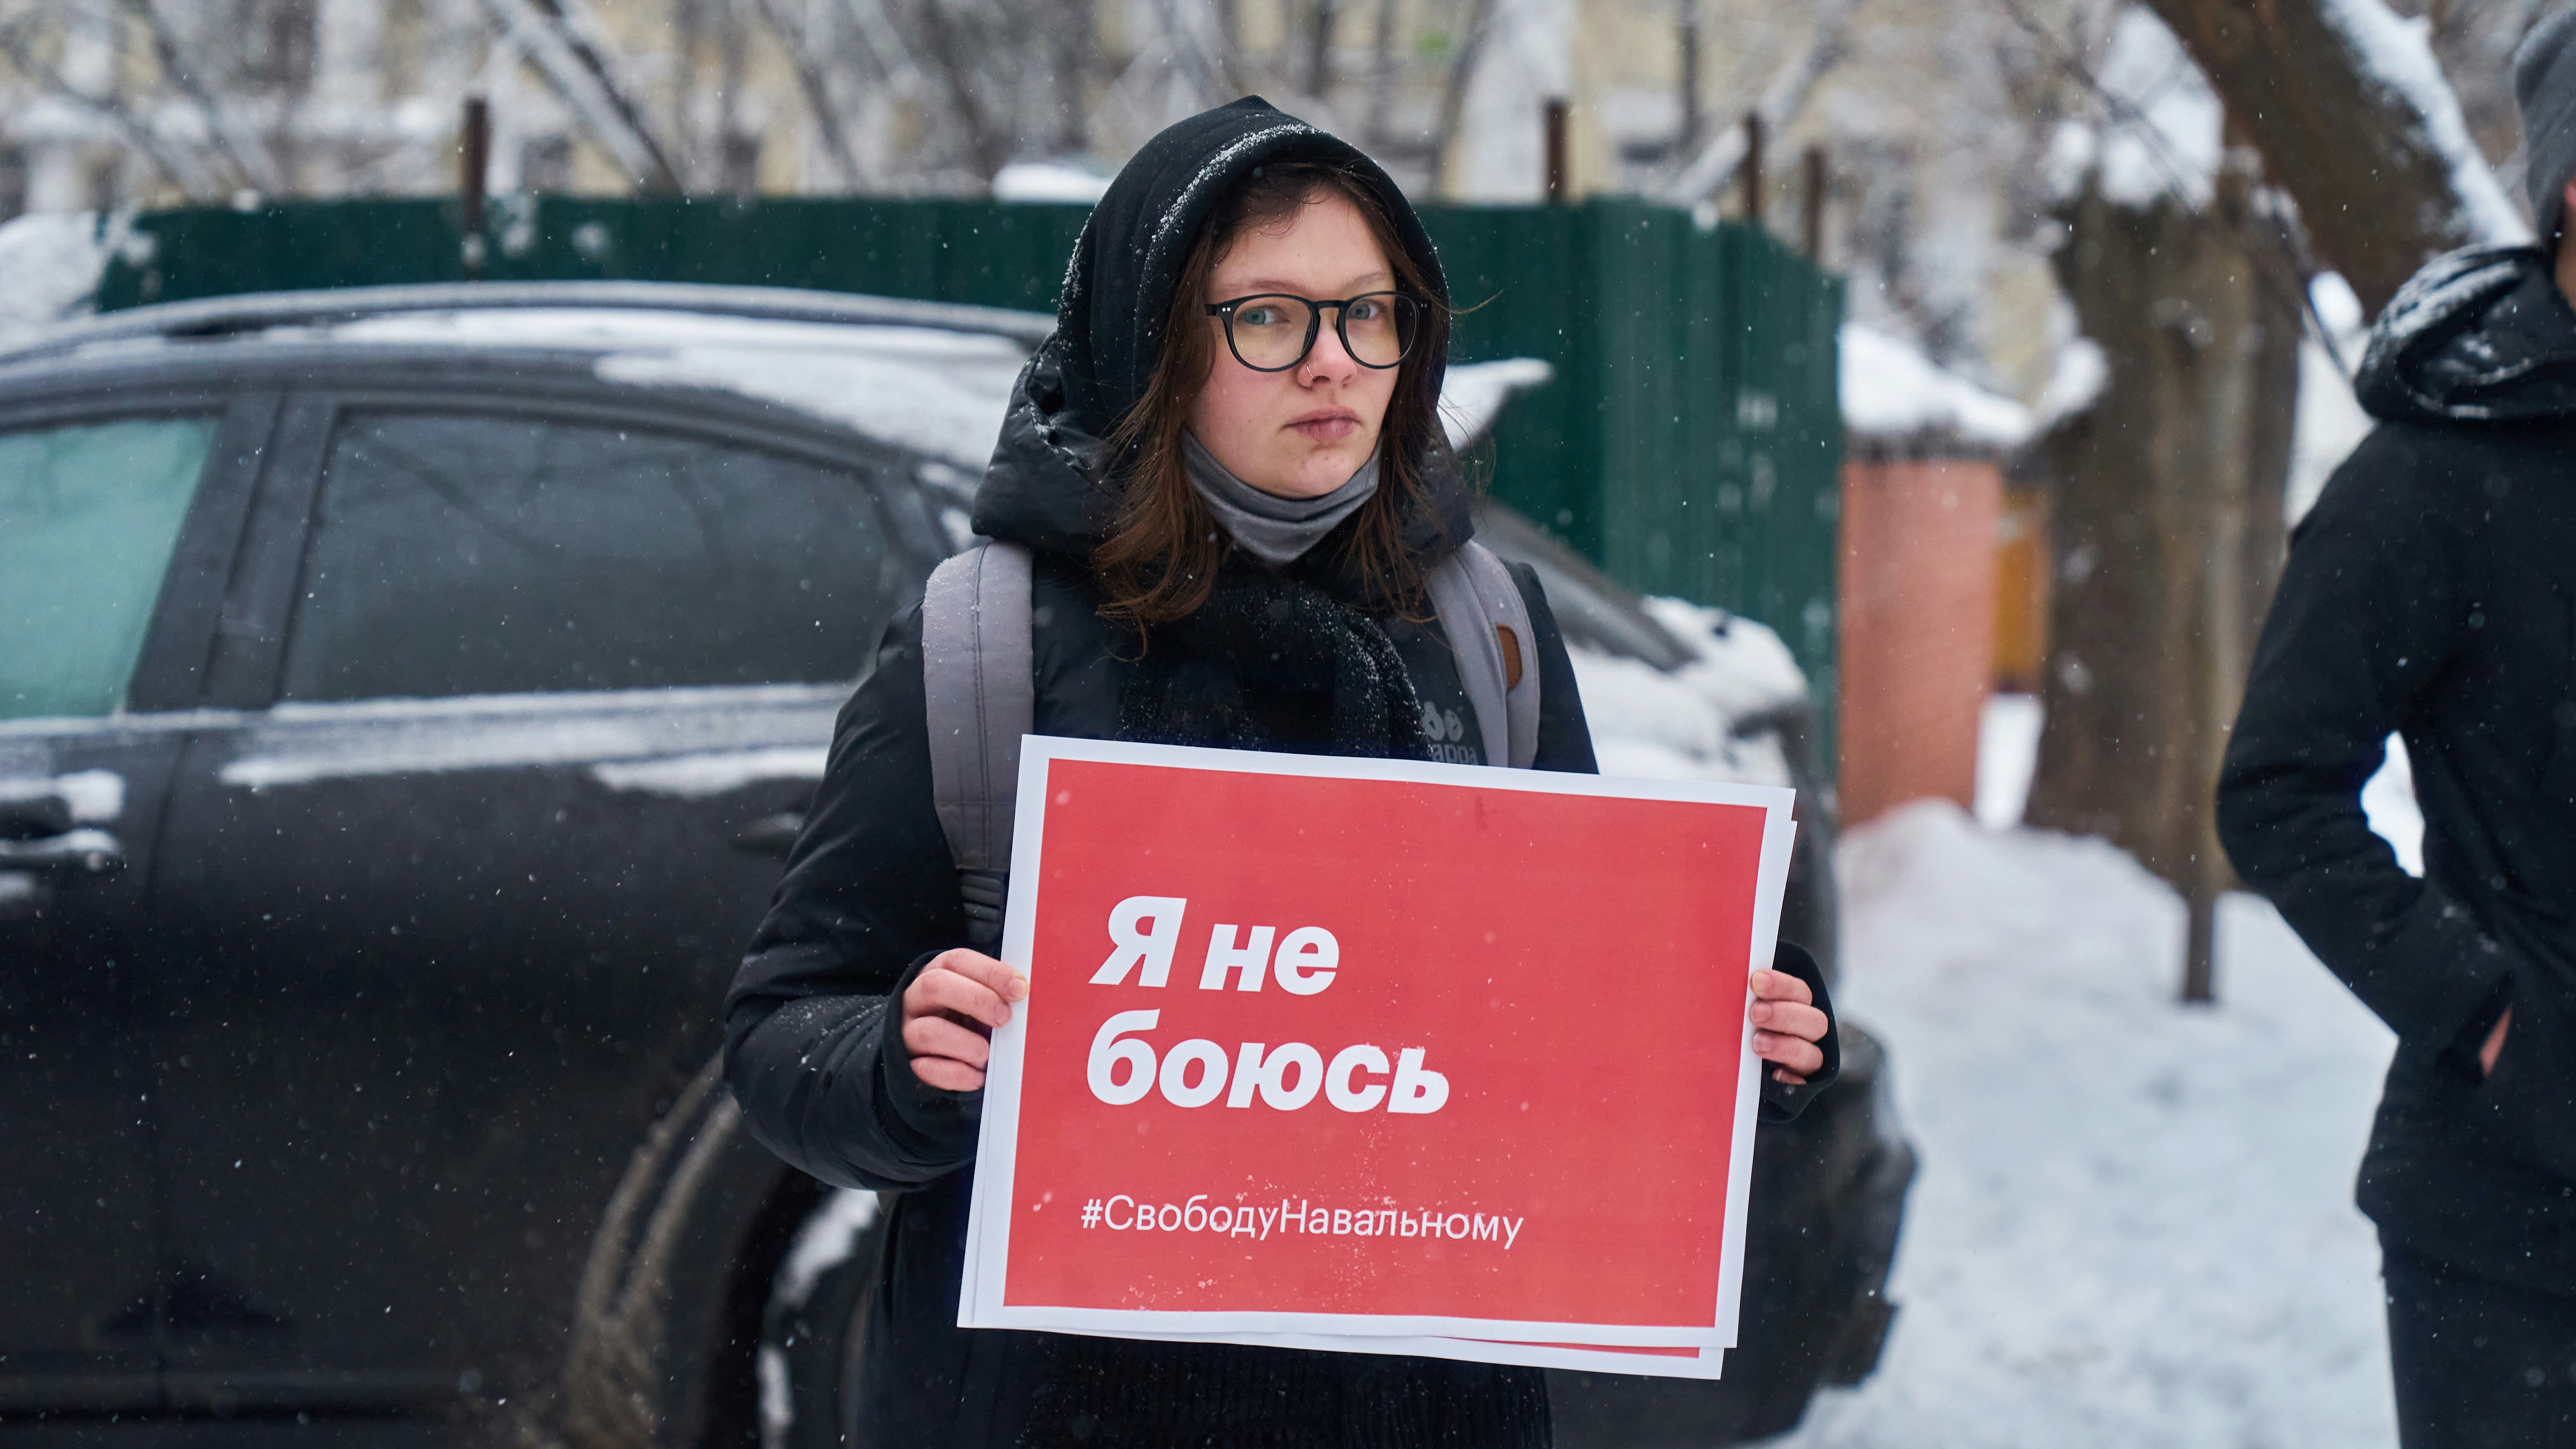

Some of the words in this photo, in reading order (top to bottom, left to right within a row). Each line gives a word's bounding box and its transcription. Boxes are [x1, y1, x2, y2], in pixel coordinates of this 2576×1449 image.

[1429, 743, 1478, 765] appa
[1088, 895, 1187, 988] Я
[1199, 924, 1339, 995] не
[1087, 1009, 1449, 1114] боюсь
[1081, 1194, 1524, 1250] #СвободуНавальному
